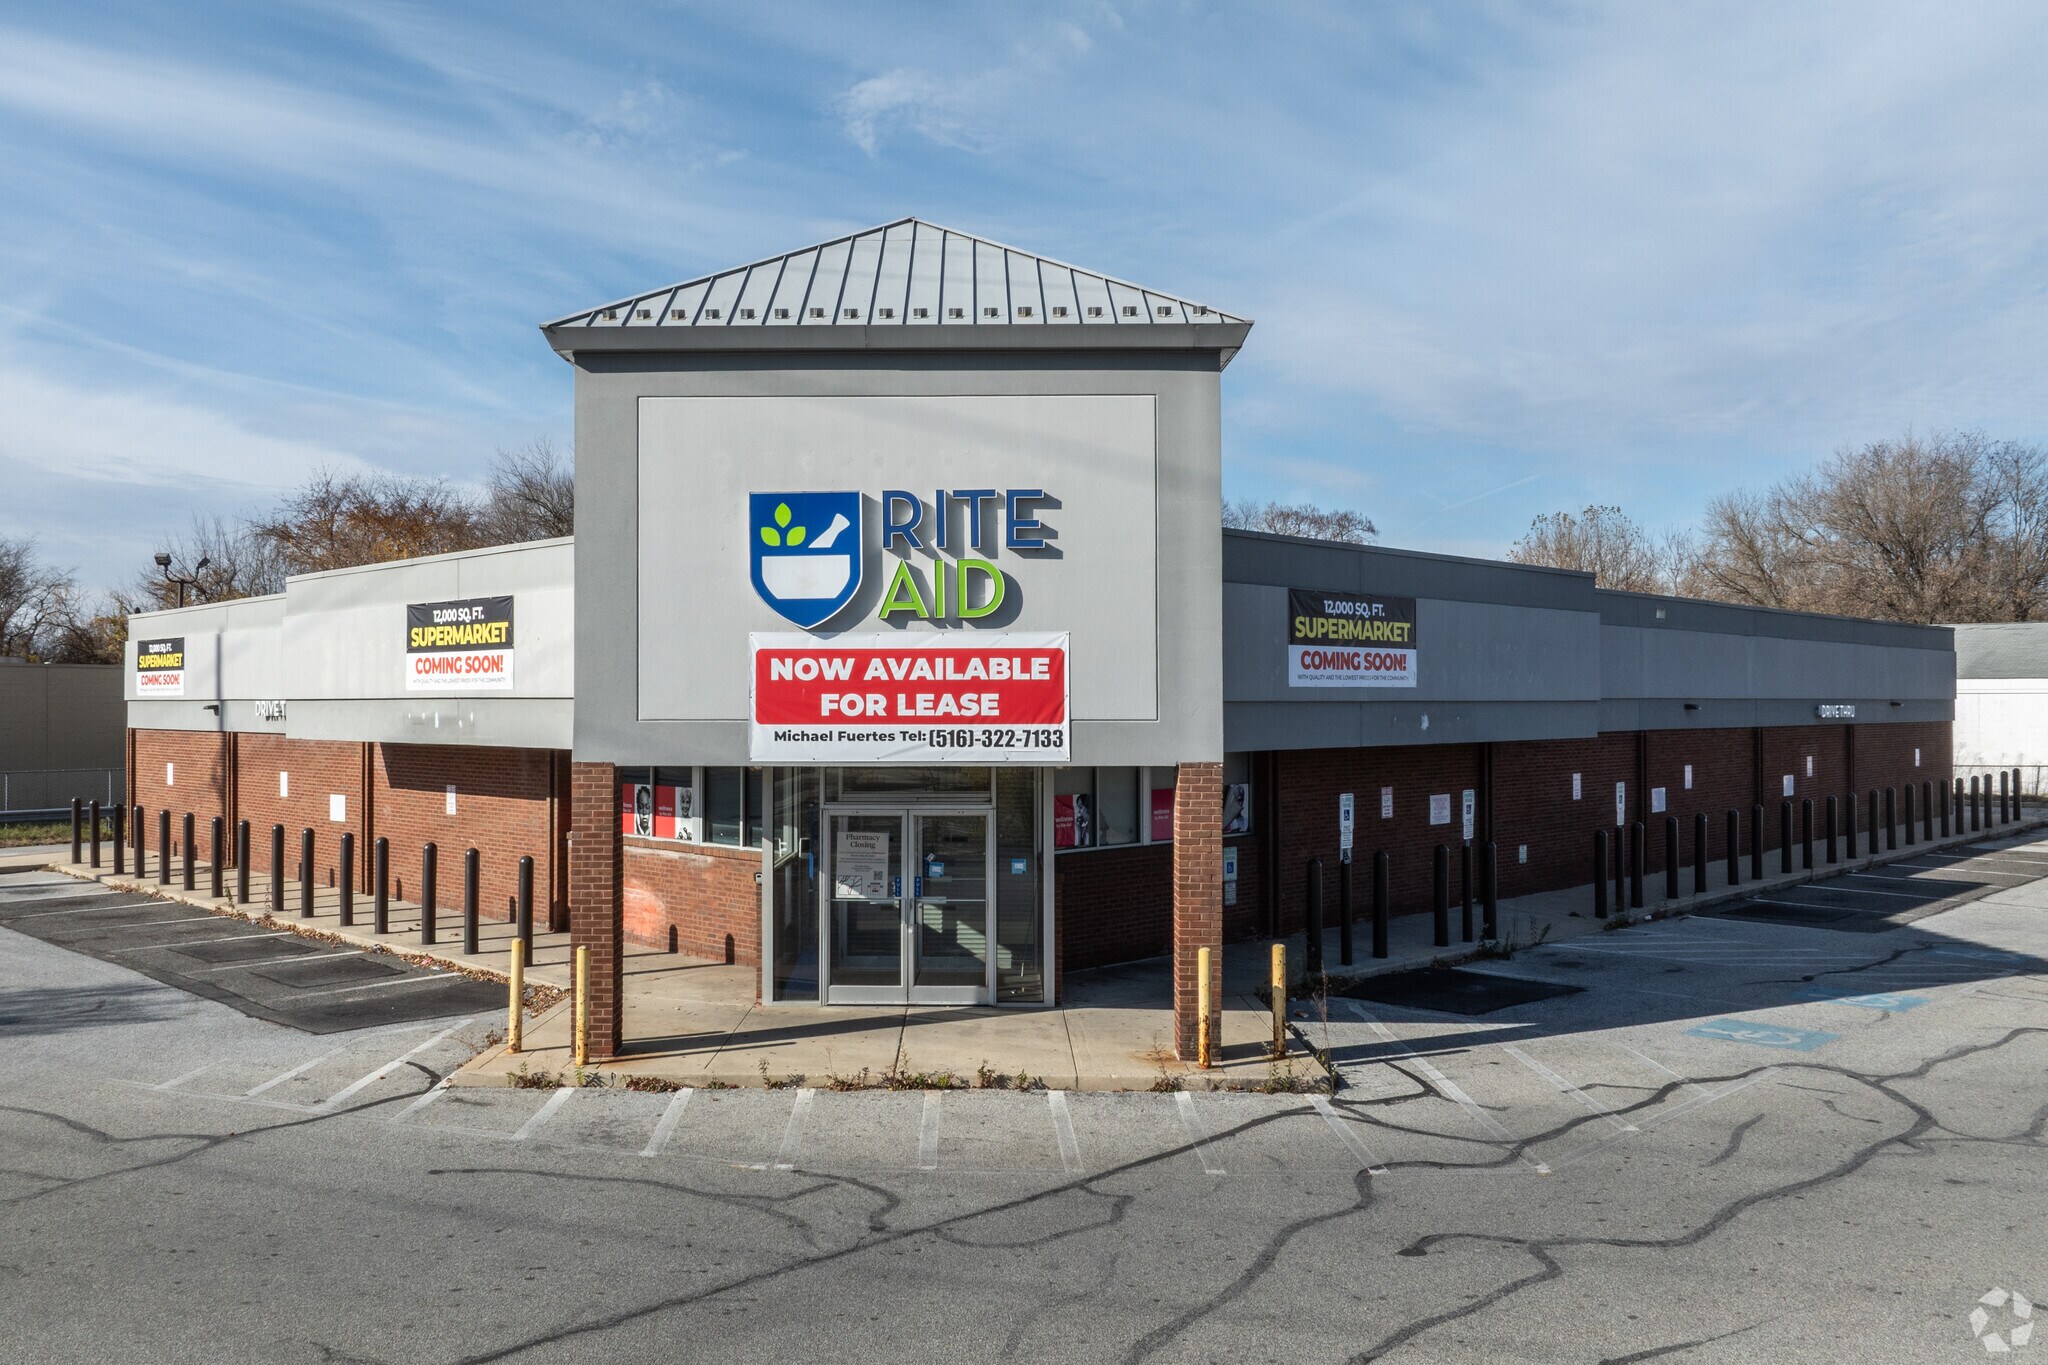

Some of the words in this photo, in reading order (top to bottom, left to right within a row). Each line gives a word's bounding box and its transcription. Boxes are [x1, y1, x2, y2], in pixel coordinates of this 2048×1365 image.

[881, 488, 1046, 550] RITE
[877, 558, 1006, 620] AID
[433, 608, 457, 625] 12,000
[457, 607, 472, 623] SQ.
[472, 606, 484, 620] FT.
[1324, 600, 1354, 616] 12,000
[1355, 602, 1371, 619] SQ.
[1372, 603, 1385, 617] FT.
[411, 621, 509, 648] SUPERMARKET
[1295, 616, 1411, 642] SUPERMARKET
[139, 653, 183, 668] SUPERMARKET
[415, 656, 462, 675] COMING
[465, 655, 504, 674] SOON!
[770, 657, 855, 681] NOW
[863, 657, 1051, 681] AVAILABLE
[1301, 650, 1361, 671] COMING
[1363, 652, 1407, 672] SOON!
[141, 674, 162, 686] COMING
[163, 674, 180, 685] SOON!
[255, 700, 279, 716] DRIVE
[820, 693, 888, 717] FOR
[897, 693, 1000, 717] LEASE
[1821, 705, 1839, 718] DRIVE
[1839, 705, 1855, 718] THRU
[774, 729, 834, 742] Michael
[837, 729, 896, 742] Fuertes
[899, 729, 927, 742] Tel:
[929, 729, 1065, 748] (516)-322-7133
[846, 833, 880, 843] Pharmacy
[850, 841, 876, 849] Closing
